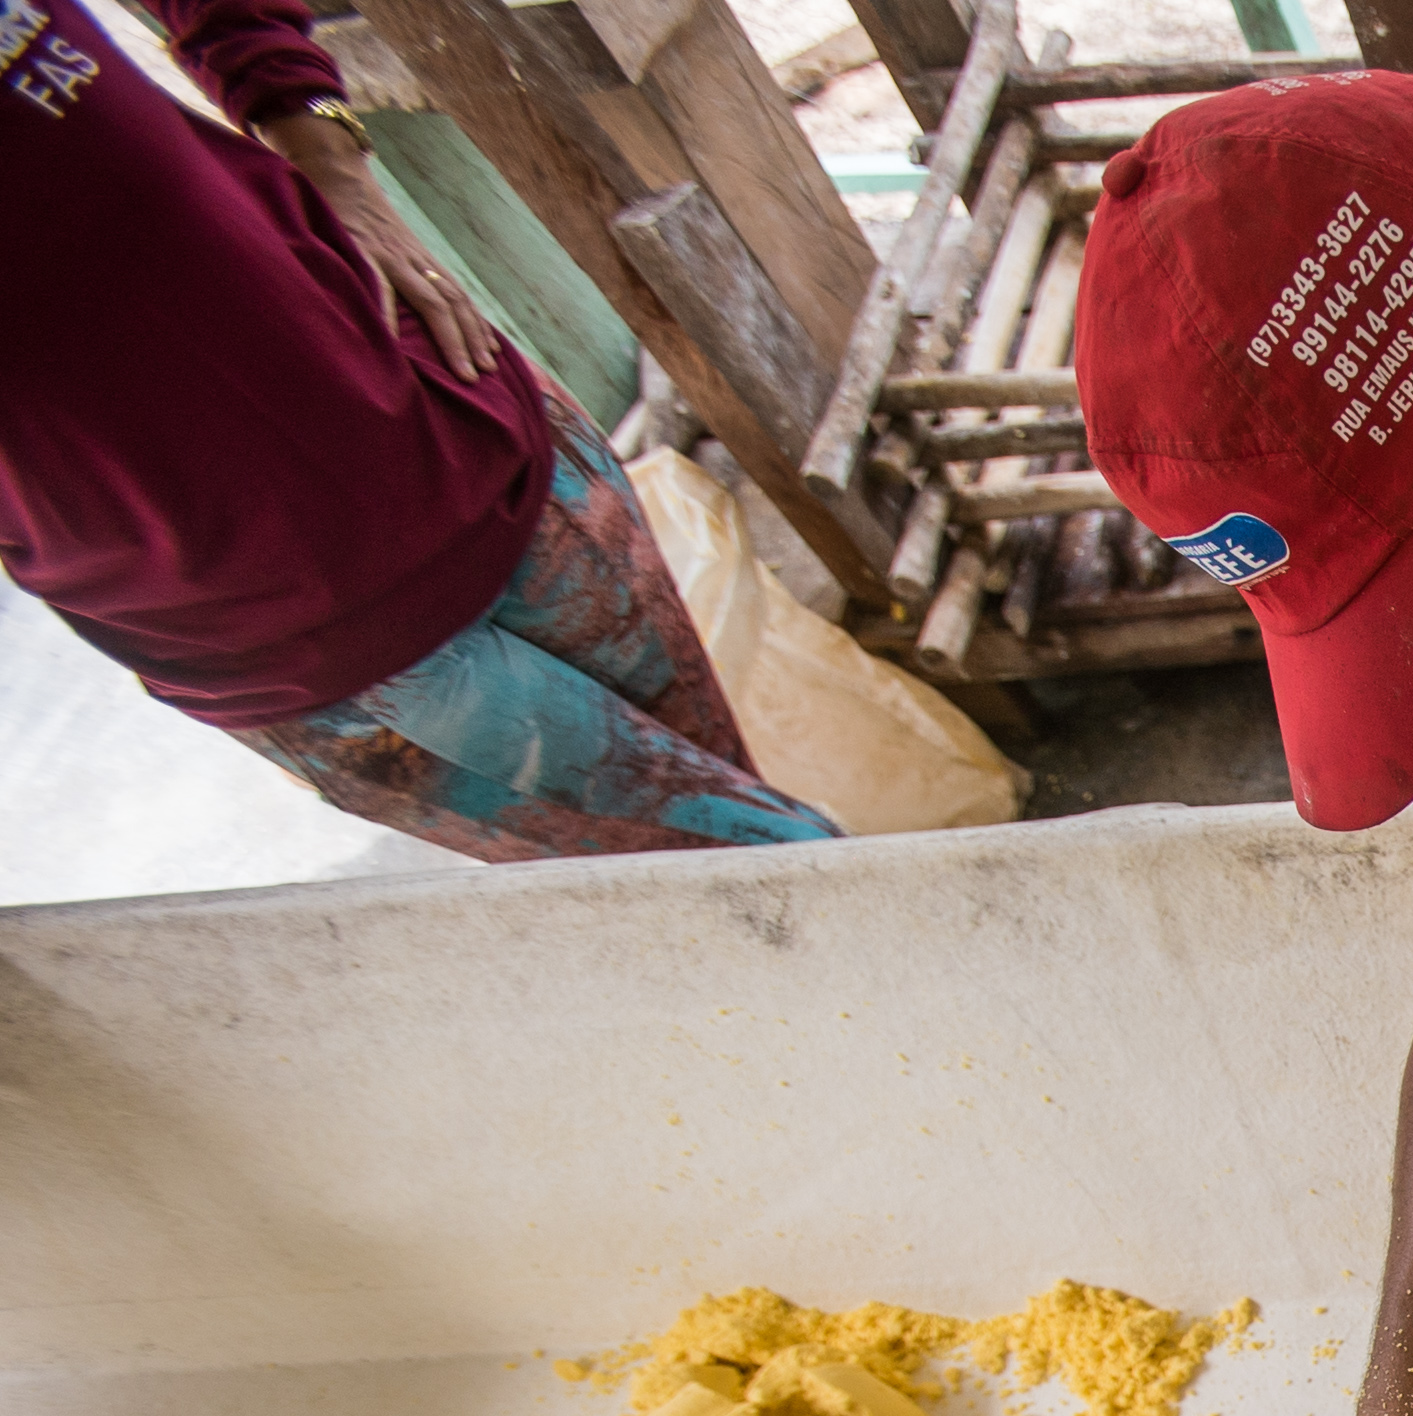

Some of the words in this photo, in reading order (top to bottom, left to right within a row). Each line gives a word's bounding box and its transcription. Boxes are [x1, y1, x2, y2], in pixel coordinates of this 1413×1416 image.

[14, 34, 100, 118] FAS
[1247, 191, 1370, 367] (97)3343-3627
[1292, 218, 1404, 366] 99144-2276
[1331, 398, 1371, 443] RUA
[1368, 425, 1393, 445] B.
